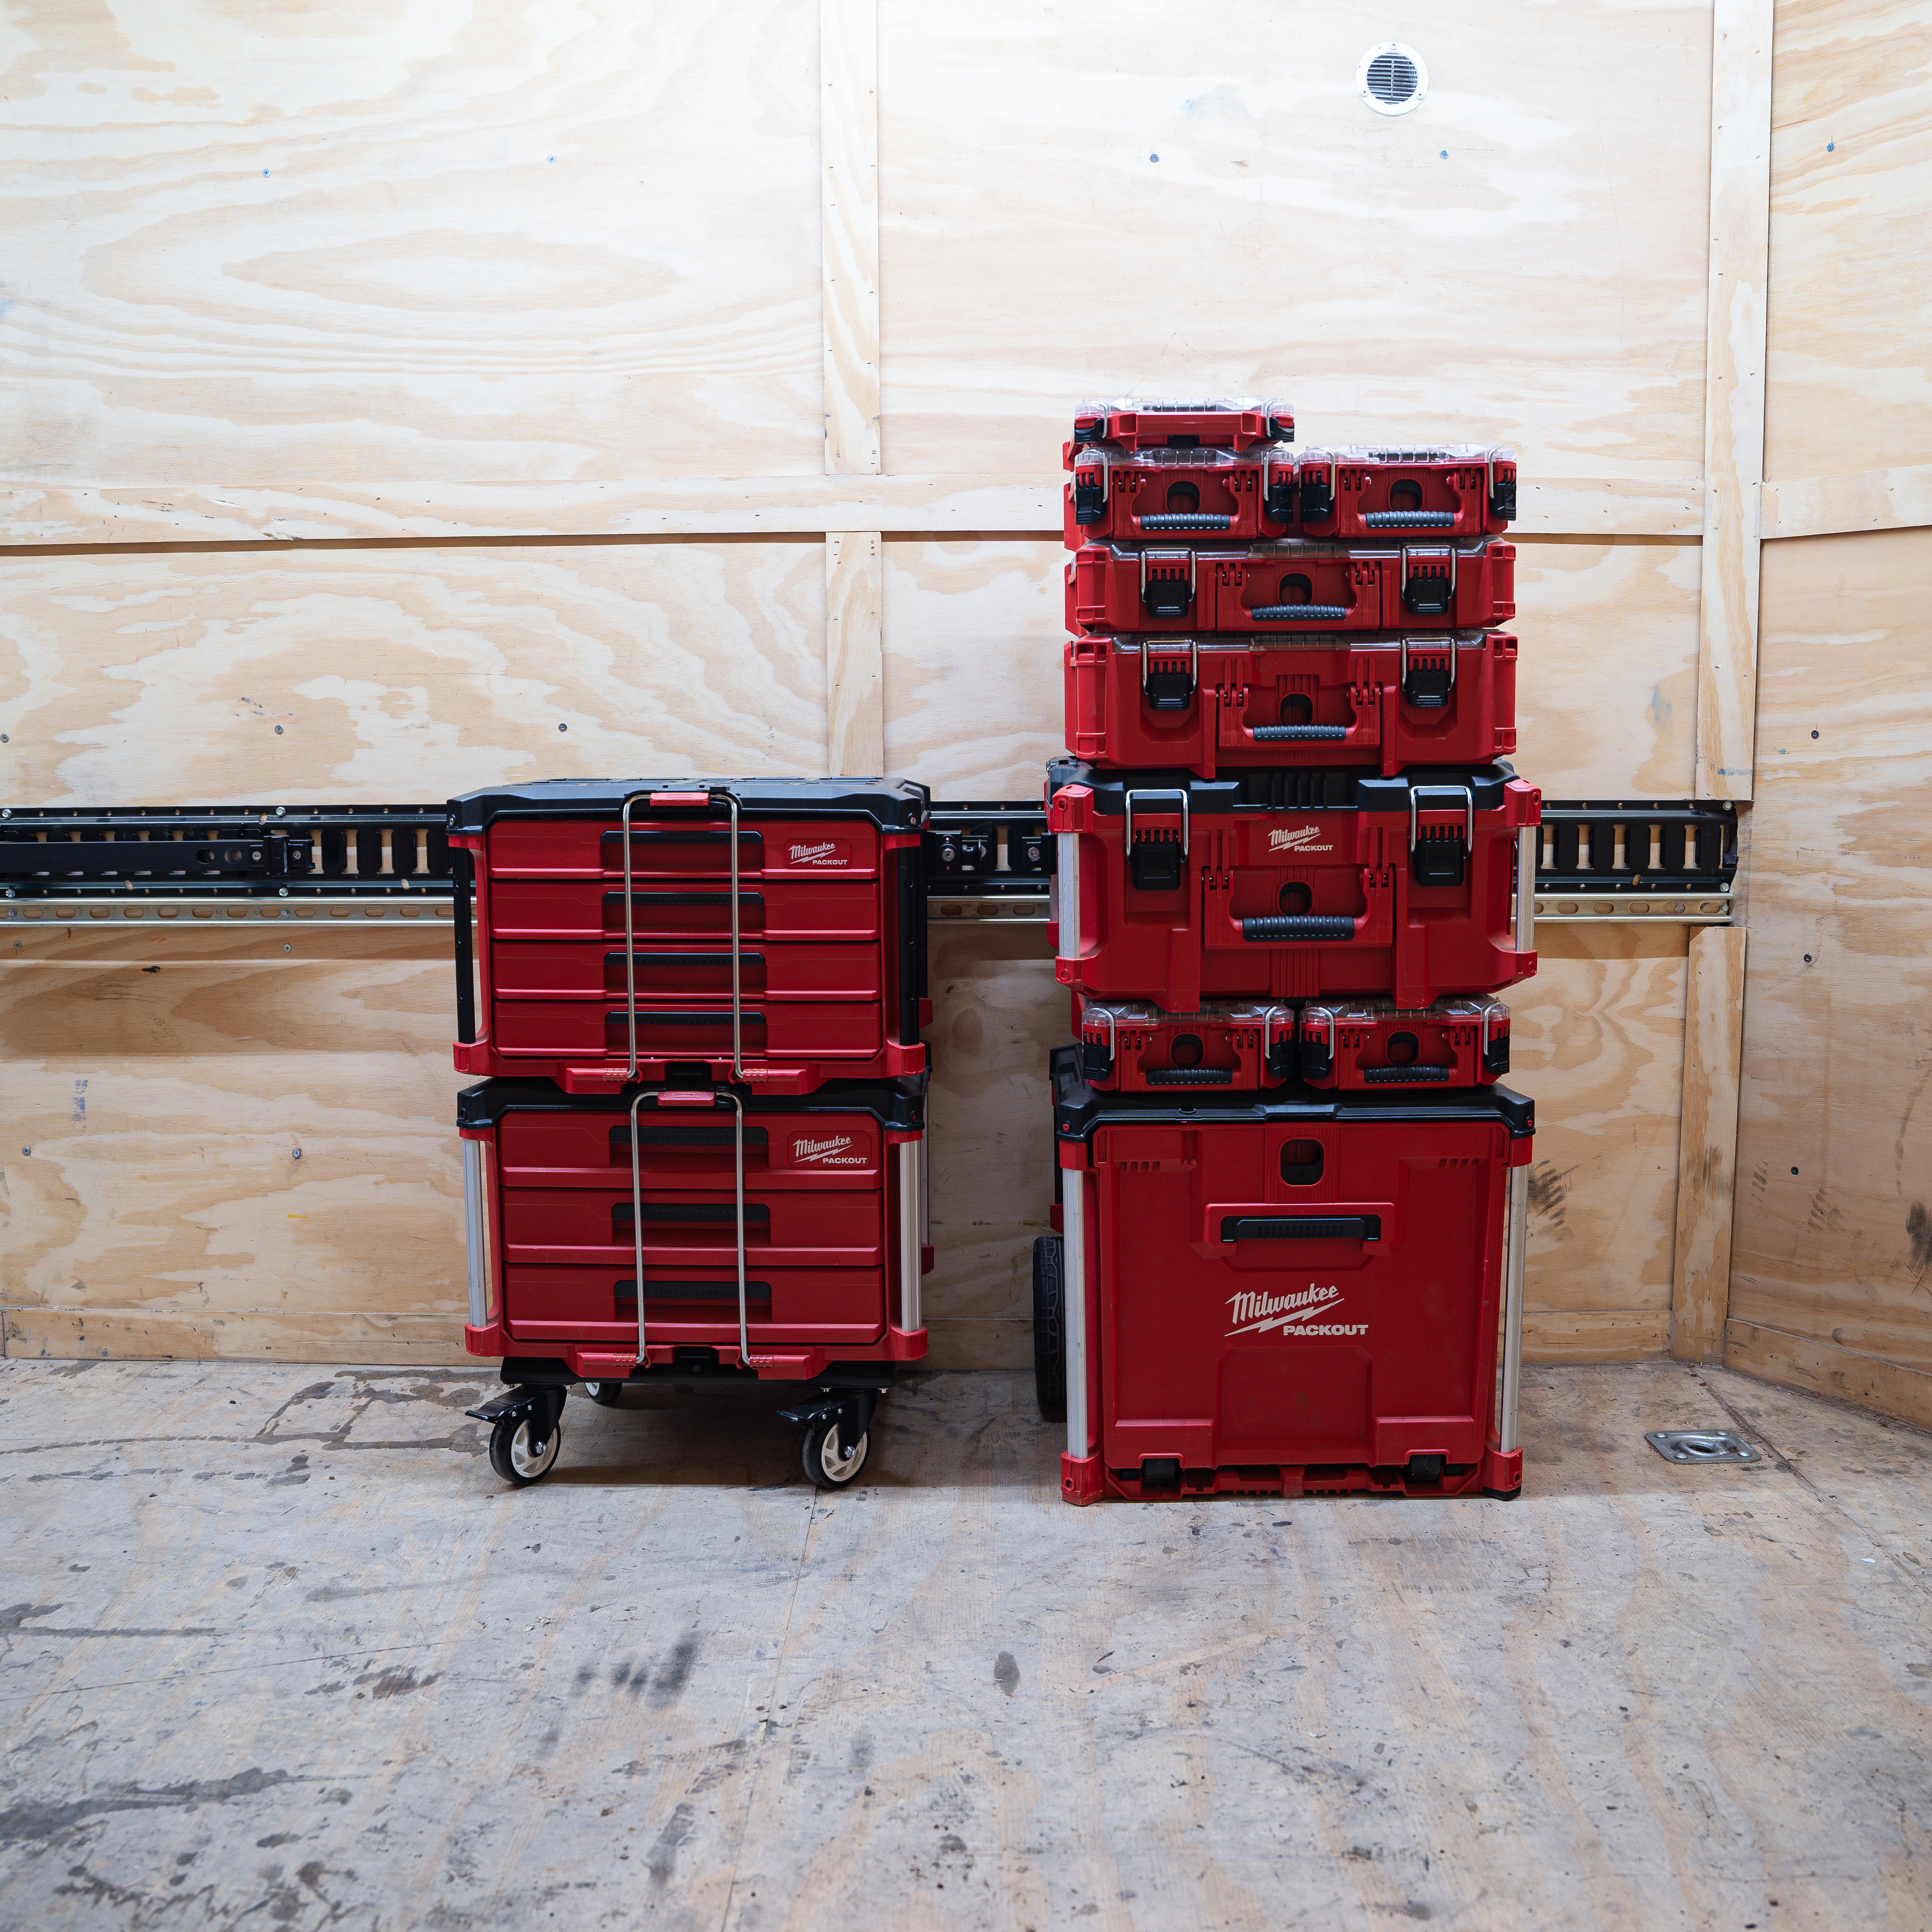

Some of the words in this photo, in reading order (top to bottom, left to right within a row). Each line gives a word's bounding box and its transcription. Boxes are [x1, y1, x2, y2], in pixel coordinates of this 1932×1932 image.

[1267, 825, 1320, 846] Milwaukee
[788, 842, 835, 860] Milwaukee
[792, 1136, 852, 1157] Milwaukee
[1225, 1283, 1339, 1324] Milwaukee
[1283, 1325, 1369, 1336] PACKOUT
